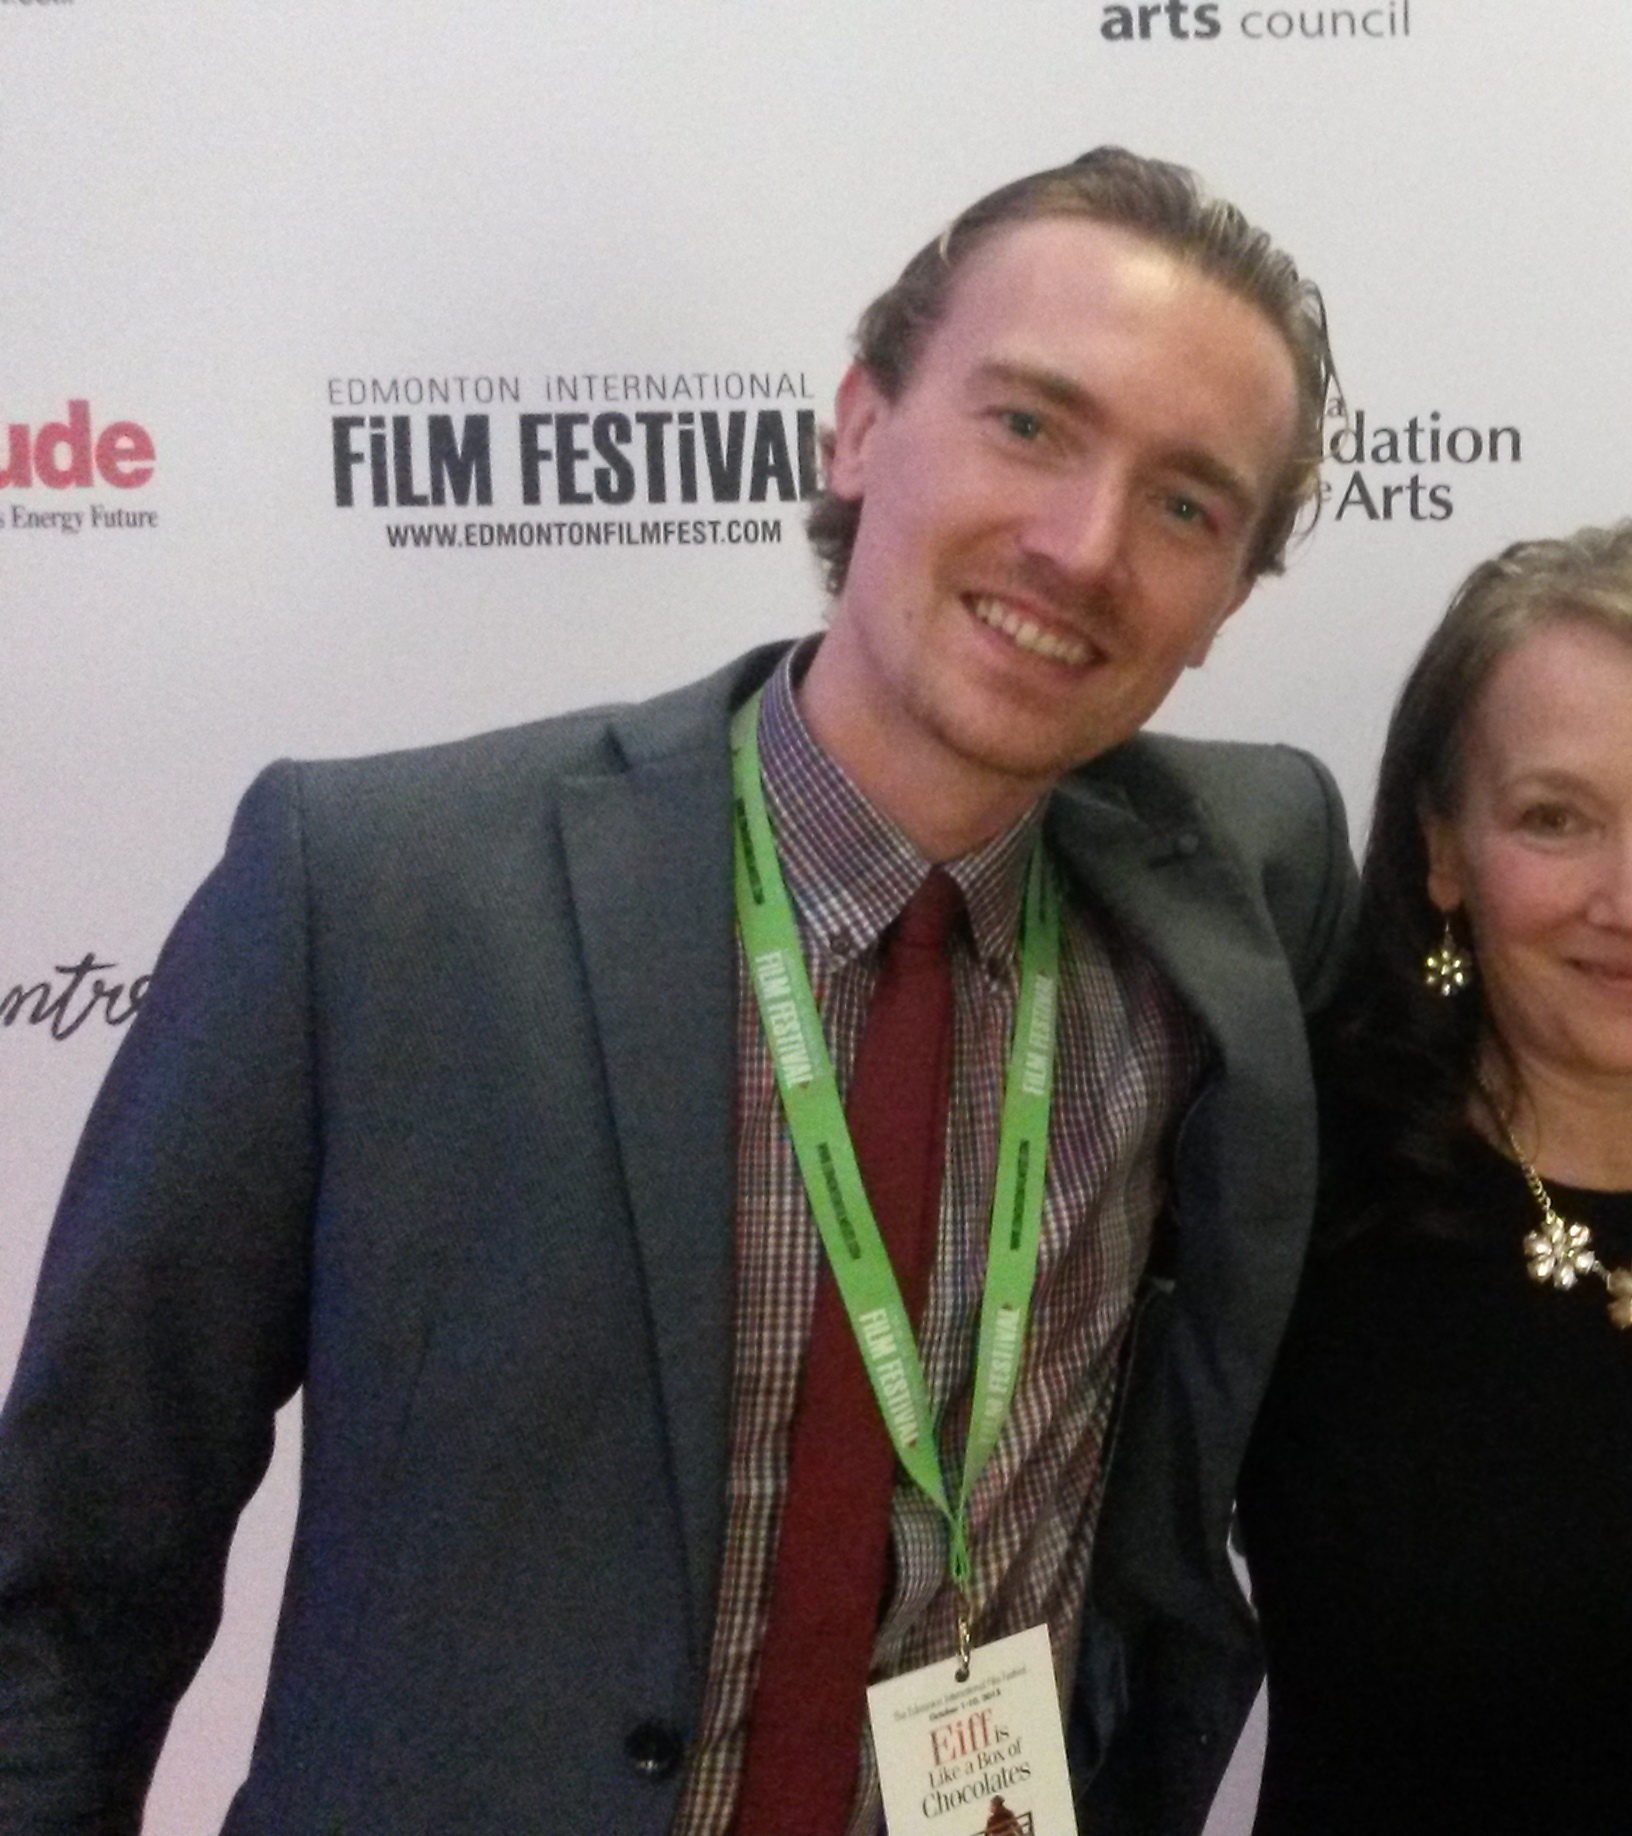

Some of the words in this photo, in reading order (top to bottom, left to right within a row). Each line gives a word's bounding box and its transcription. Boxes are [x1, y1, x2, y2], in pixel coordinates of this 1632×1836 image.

[1100, 0, 1221, 41] arts
[1241, 0, 1410, 39] council
[328, 376, 520, 405] EDMONTON
[1328, 410, 1522, 464] dation
[11, 505, 83, 534] Energy
[91, 505, 158, 528] Future
[1335, 470, 1454, 521] Arts
[387, 519, 783, 549] WWW.EDMONTONFILMFEST.COM
[928, 1764, 961, 1789] Like
[964, 1761, 974, 1774] a
[977, 1749, 1006, 1770] Box
[1008, 1737, 1022, 1756] of
[930, 1708, 992, 1767] Eiff
[994, 1725, 1009, 1744] is
[922, 1761, 1032, 1819] Chocolates
